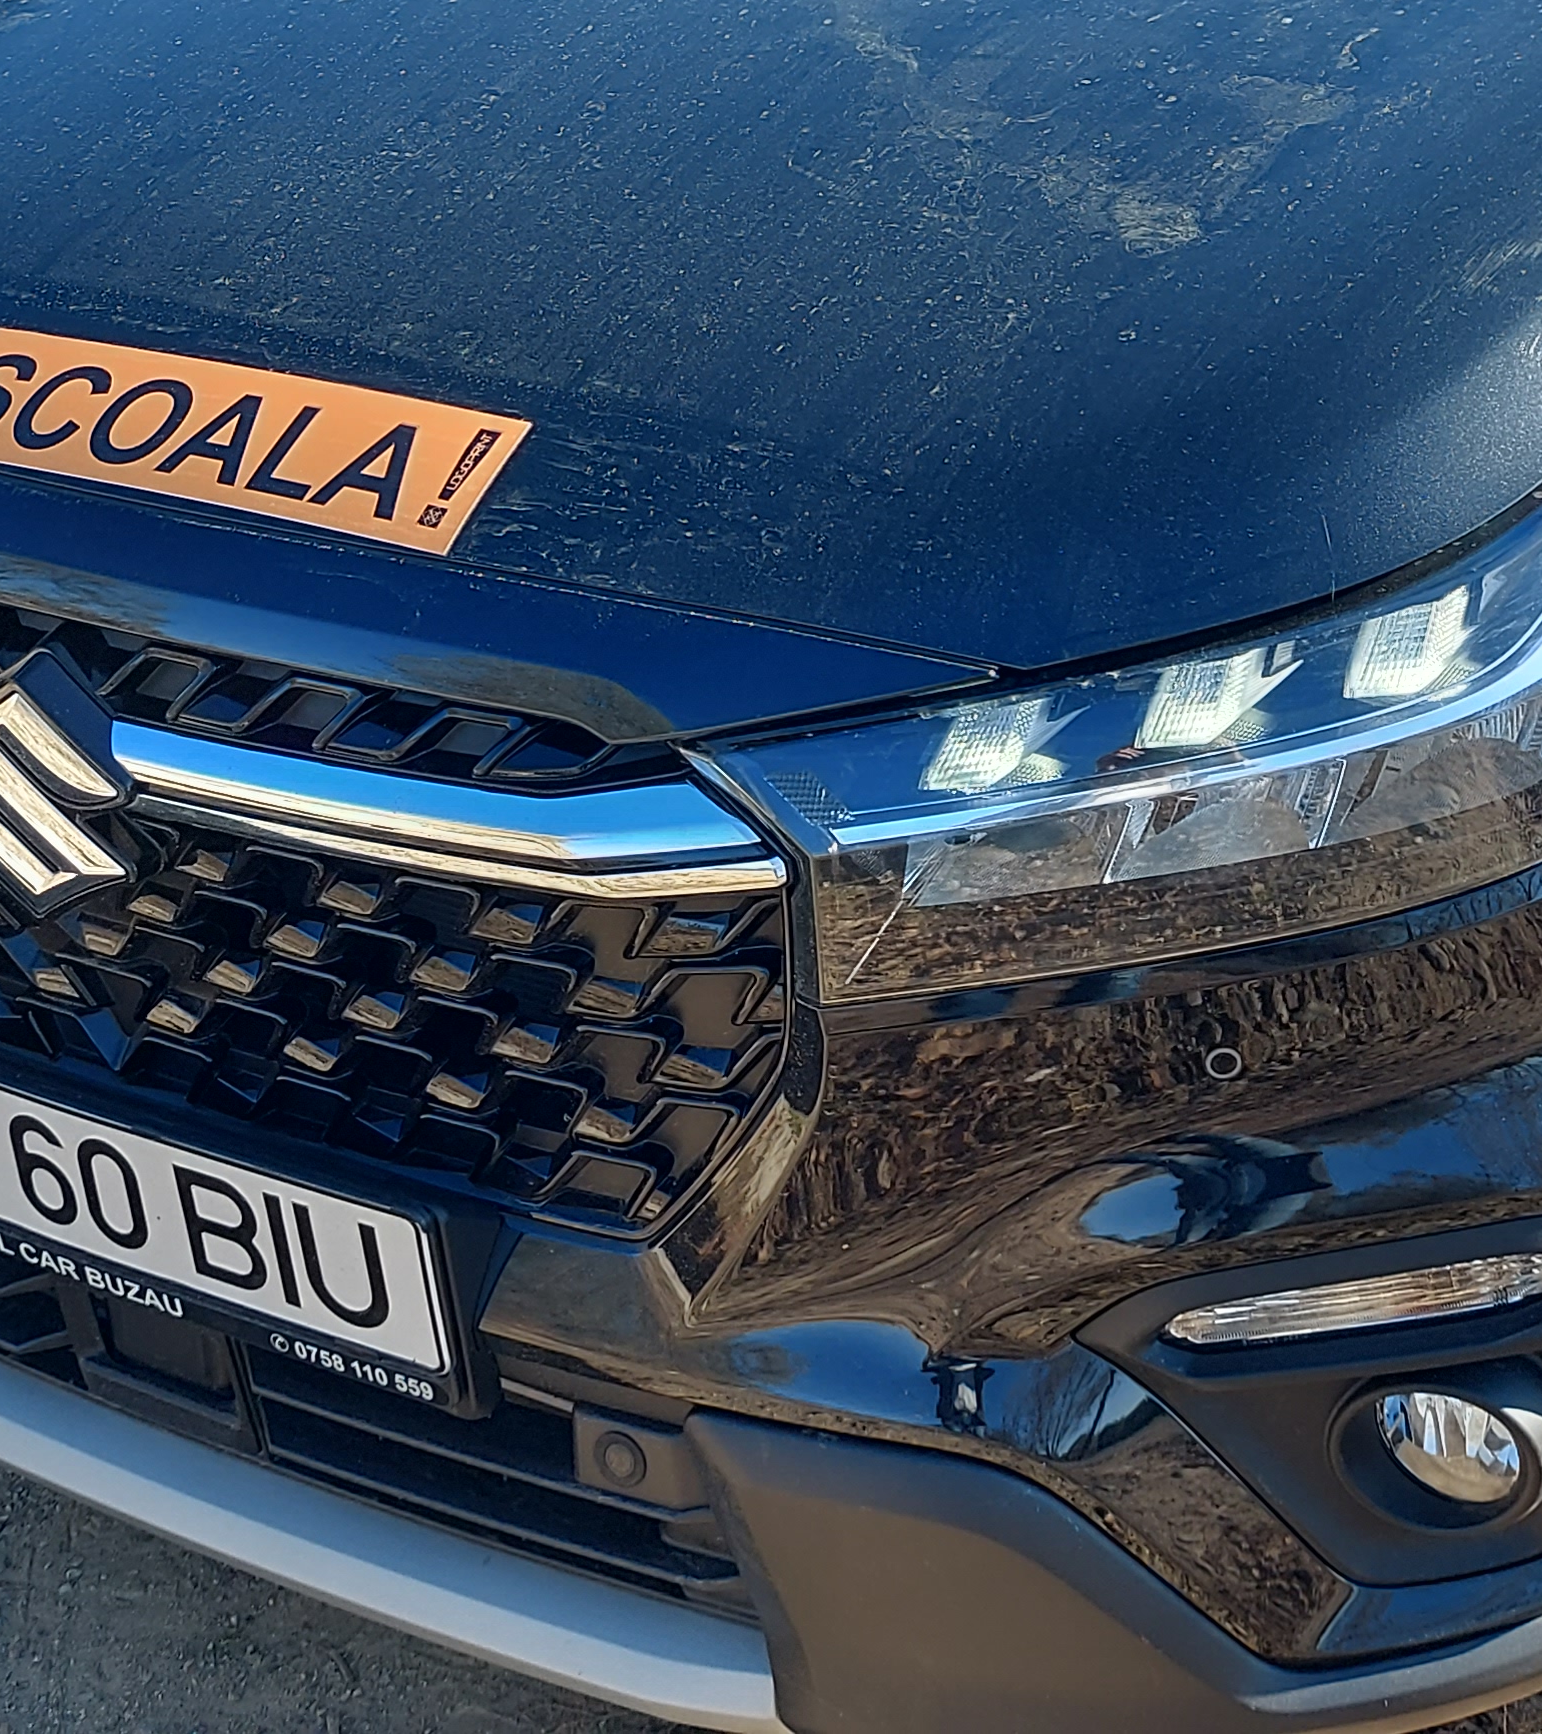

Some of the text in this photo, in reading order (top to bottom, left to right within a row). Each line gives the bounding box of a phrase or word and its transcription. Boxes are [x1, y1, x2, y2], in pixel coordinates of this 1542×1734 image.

[445, 432, 494, 491] LOGOPRINT
[9, 1114, 149, 1250] 60
[172, 1163, 390, 1329] BIU
[18, 1241, 81, 1281] CAR
[84, 1265, 184, 1318] BUZAU
[293, 1340, 435, 1402] 0758 110 559
